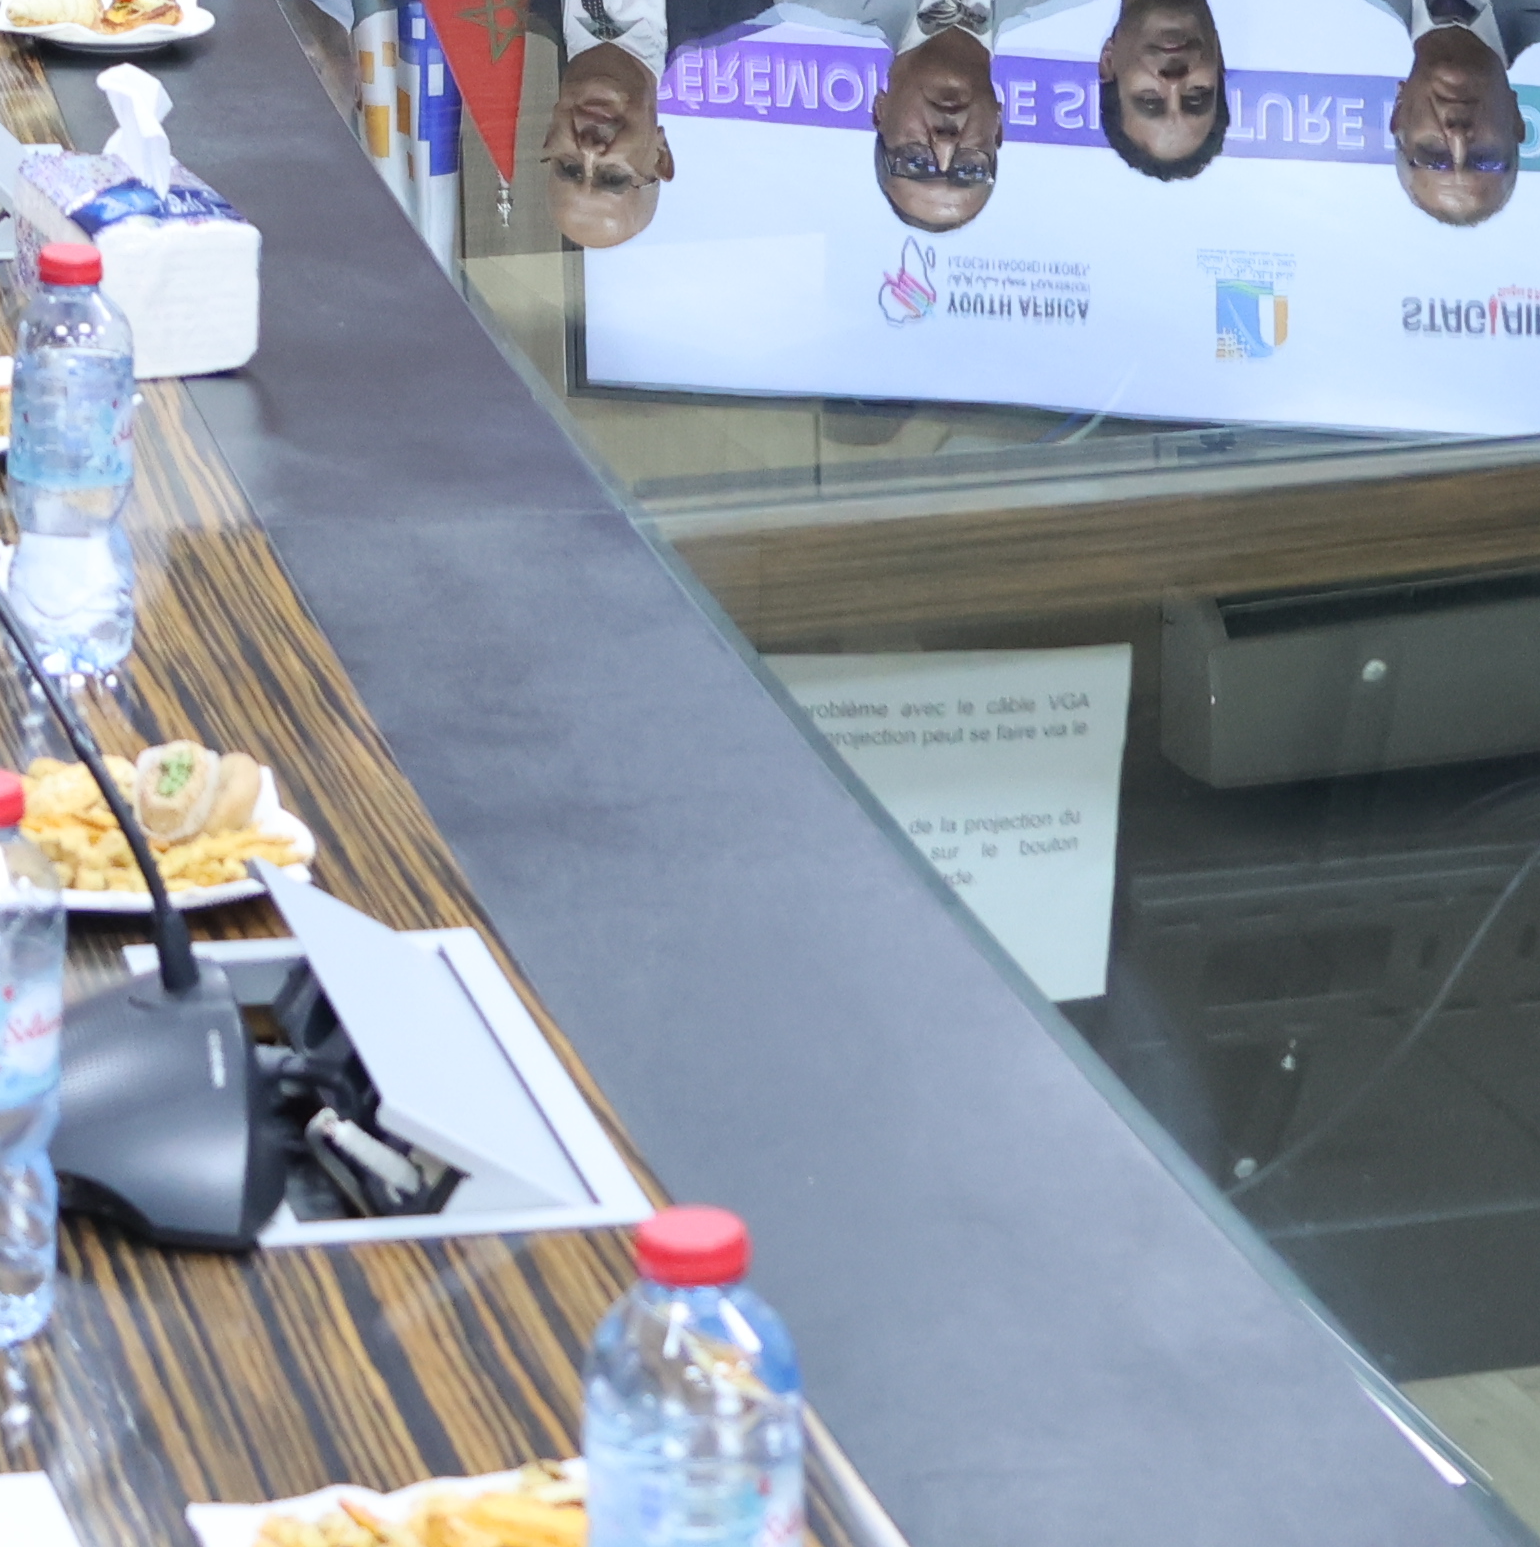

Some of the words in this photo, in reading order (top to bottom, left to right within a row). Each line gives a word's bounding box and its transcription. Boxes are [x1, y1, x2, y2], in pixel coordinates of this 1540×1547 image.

[900, 702, 946, 719] avec
[957, 698, 975, 716] le
[1048, 691, 1090, 711] VGA
[969, 729, 991, 744] se
[1072, 719, 1088, 736] le
[939, 815, 957, 834] la
[964, 810, 1053, 836] projection
[930, 845, 959, 860] sur
[981, 842, 999, 859] le
[1019, 835, 1079, 857] bouton
